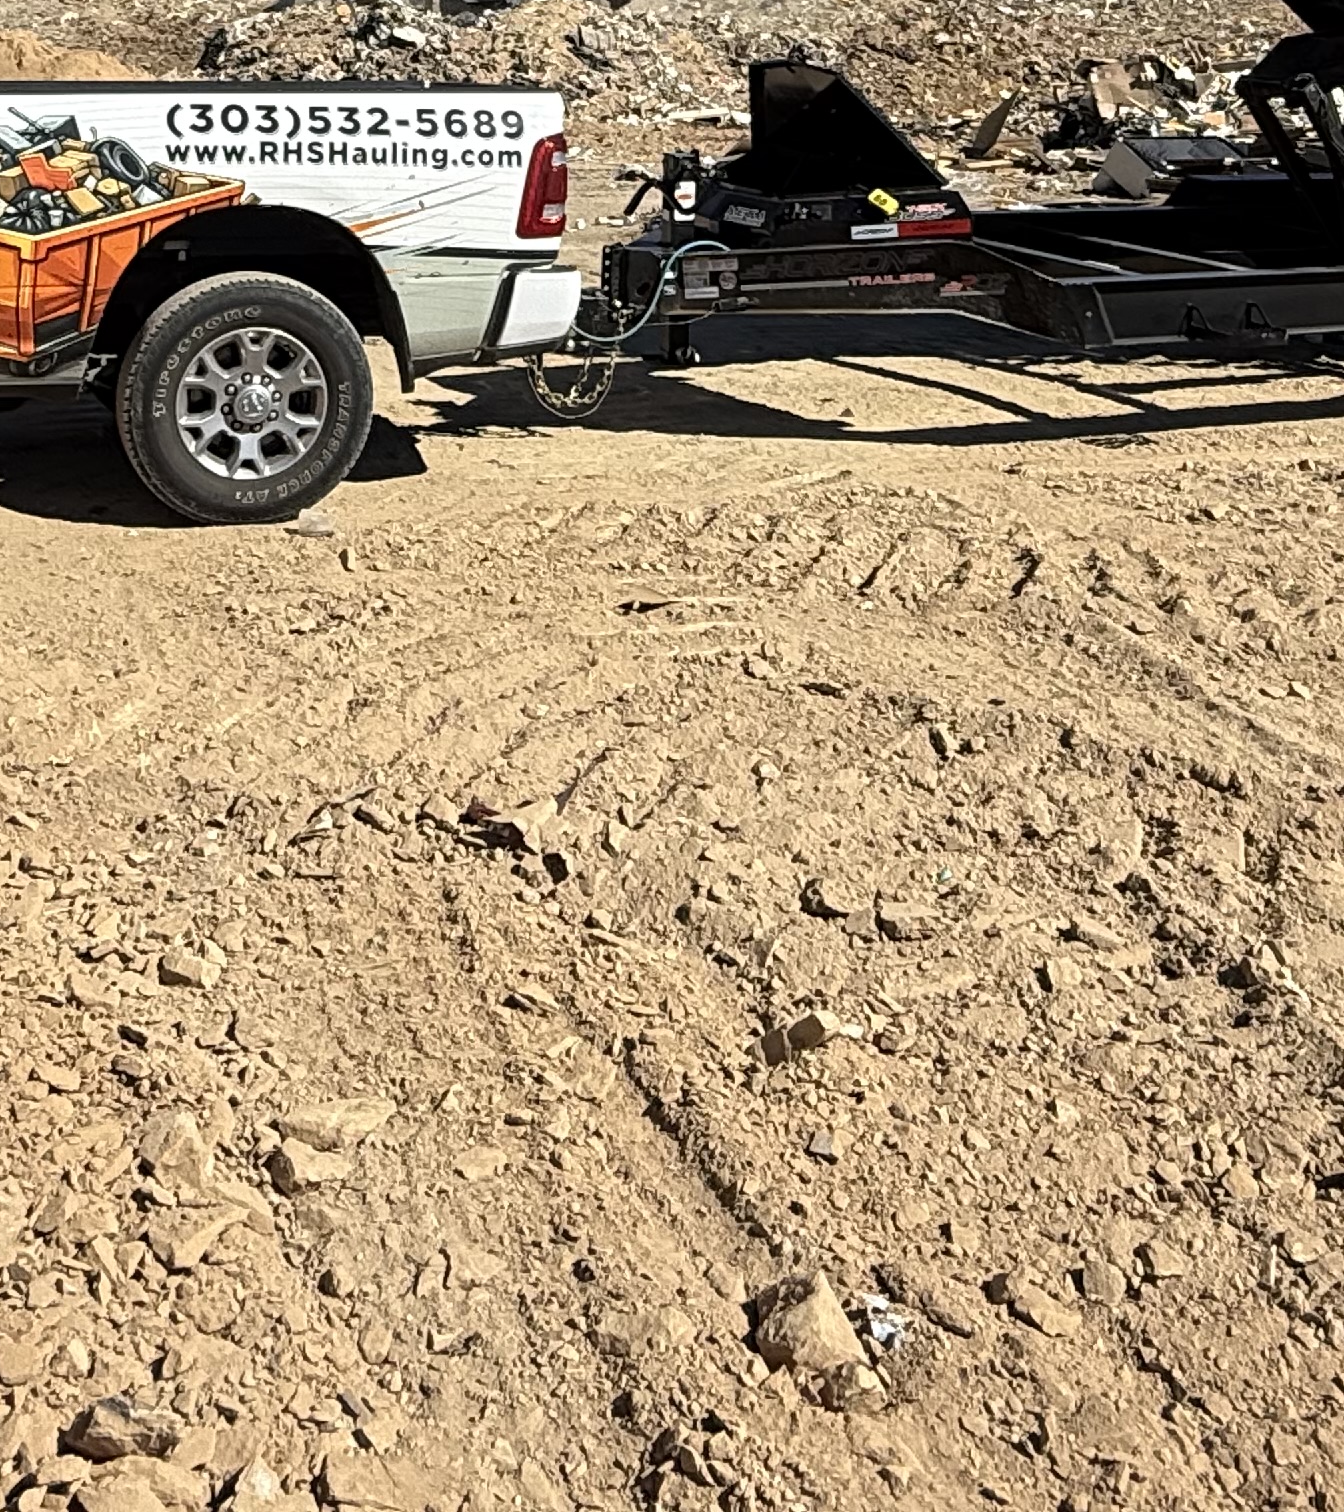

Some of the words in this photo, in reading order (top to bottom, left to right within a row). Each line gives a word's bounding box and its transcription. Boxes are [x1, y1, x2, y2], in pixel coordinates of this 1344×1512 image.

[165, 103, 525, 139] (303)532-5689
[165, 141, 523, 170] www.RHSHauling.com
[848, 272, 936, 287] TRAILERS
